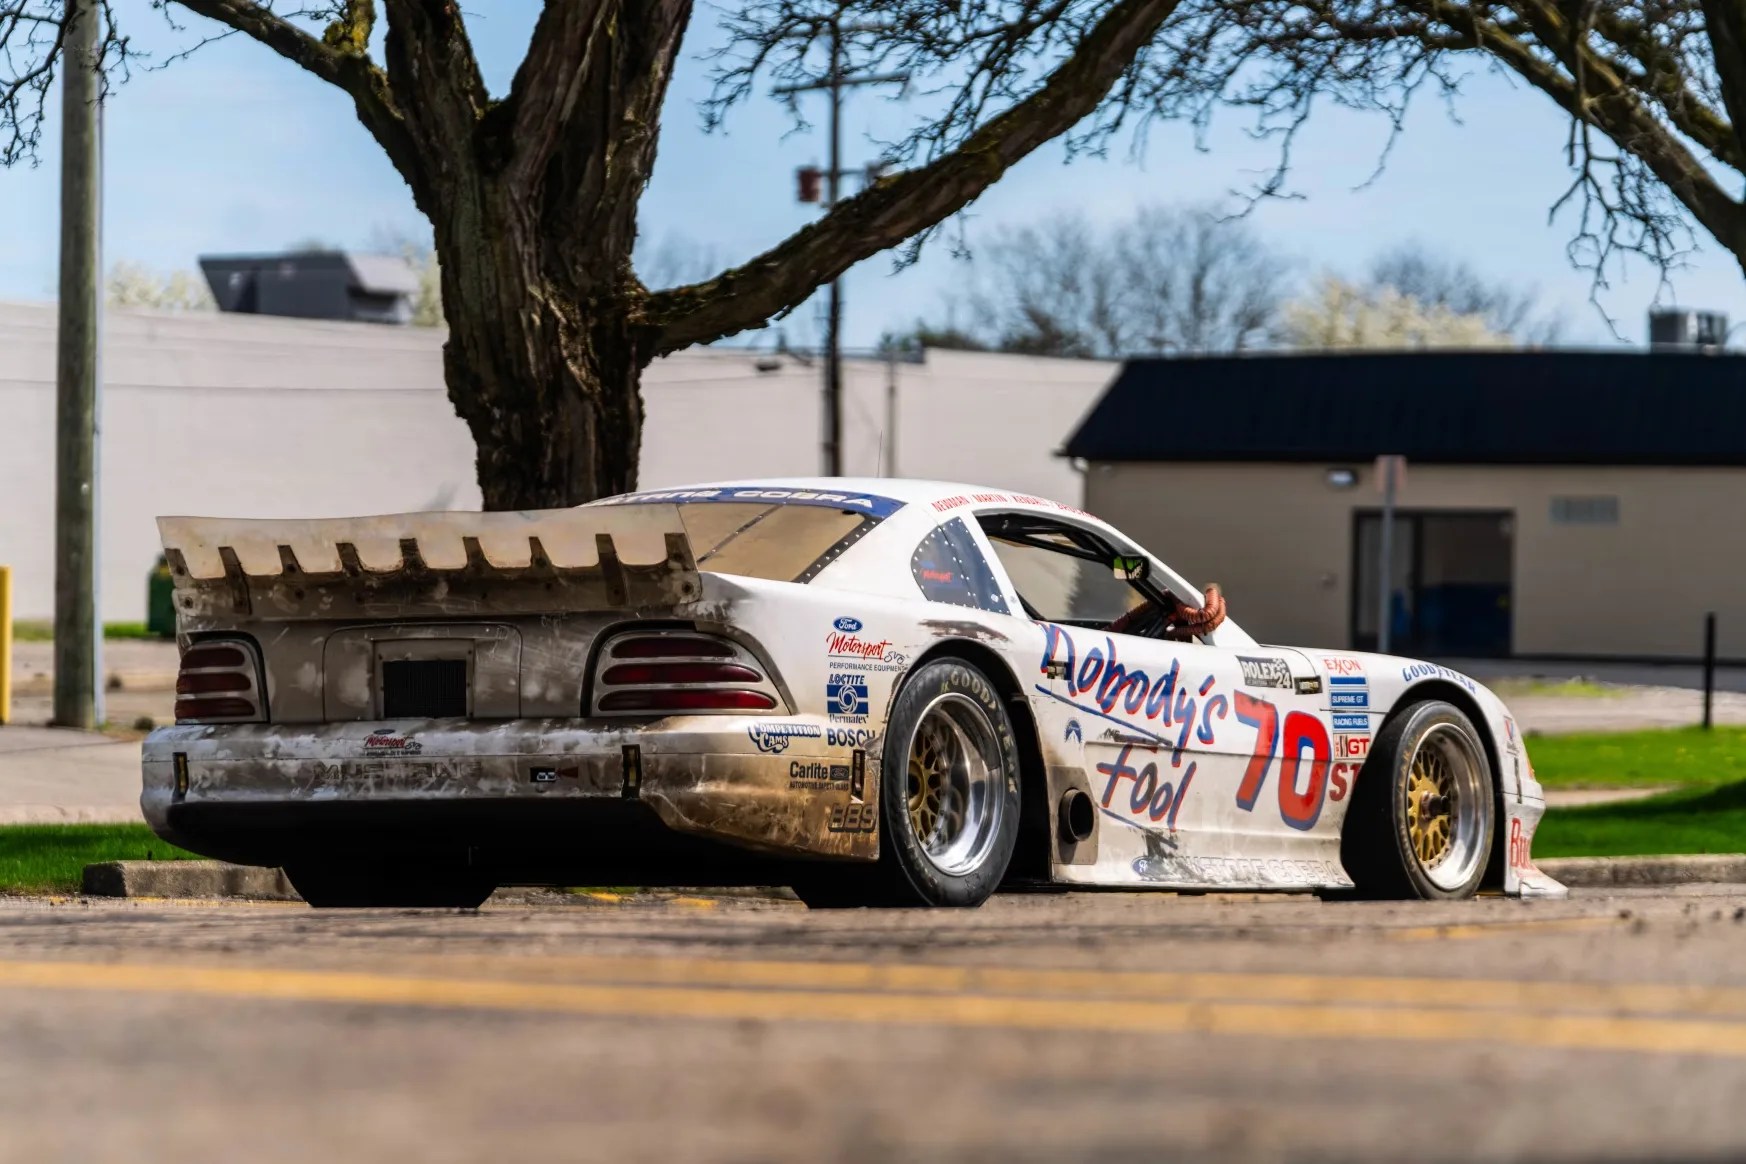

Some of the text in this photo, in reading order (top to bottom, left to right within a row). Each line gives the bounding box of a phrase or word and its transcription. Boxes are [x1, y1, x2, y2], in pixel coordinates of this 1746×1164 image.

[733, 489, 873, 508] COBRA
[931, 495, 970, 513] NEWMAN
[838, 618, 858, 631] Ford
[826, 631, 893, 660] Motorsport
[829, 662, 908, 673] PERFORMANCE EQUIPMENT
[1240, 660, 1276, 680] ROLEX
[1323, 658, 1362, 675] EXXON
[828, 673, 865, 685] LOCTITE
[1275, 671, 1291, 689] 24
[1332, 694, 1364, 704] SUPREME GT
[829, 714, 869, 724] Permatex
[1333, 716, 1368, 727] RACING FUELS
[748, 722, 822, 744] COMPETITION
[757, 732, 790, 753] CAMS
[1348, 738, 1370, 755] GT
[1233, 689, 1332, 830] 70
[790, 761, 829, 780] Carlite
